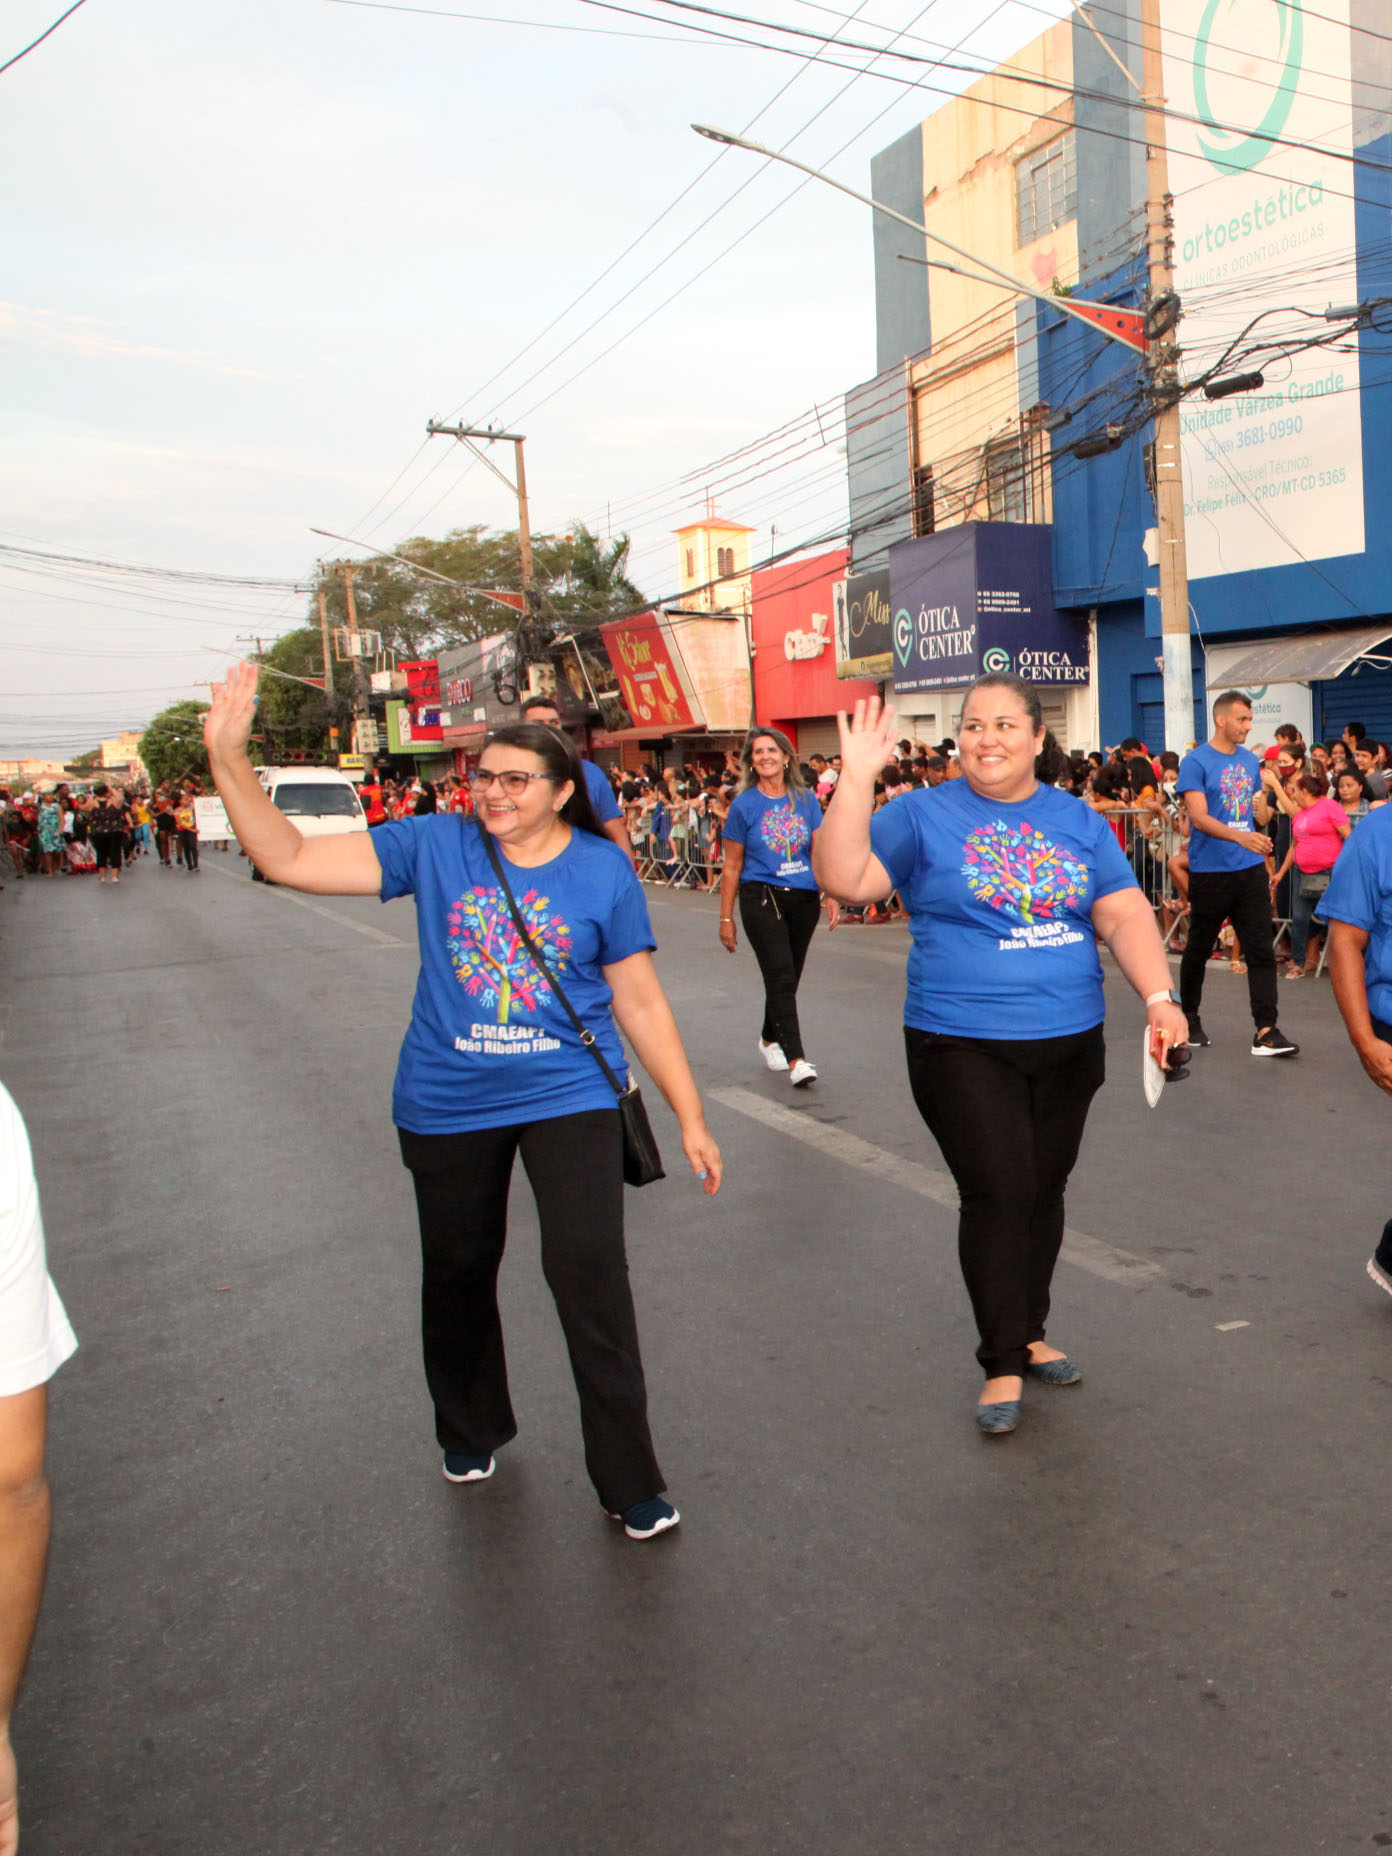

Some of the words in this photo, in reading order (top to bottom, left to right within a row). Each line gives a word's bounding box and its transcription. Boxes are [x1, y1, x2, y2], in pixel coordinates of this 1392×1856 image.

[1182, 178, 1324, 263] ortoestética
[1180, 403, 1232, 436] Unidade
[1287, 370, 1345, 404] Grande
[1237, 415, 1303, 449] 3681-0990
[1197, 498, 1223, 514] Felipe
[1319, 467, 1347, 489] 5365
[919, 603, 960, 634] ÓTICA
[1018, 647, 1072, 666] ÓTICA
[1251, 704, 1281, 714] estética
[483, 1039, 531, 1054] Ribeiro
[532, 1037, 561, 1052] Filho
